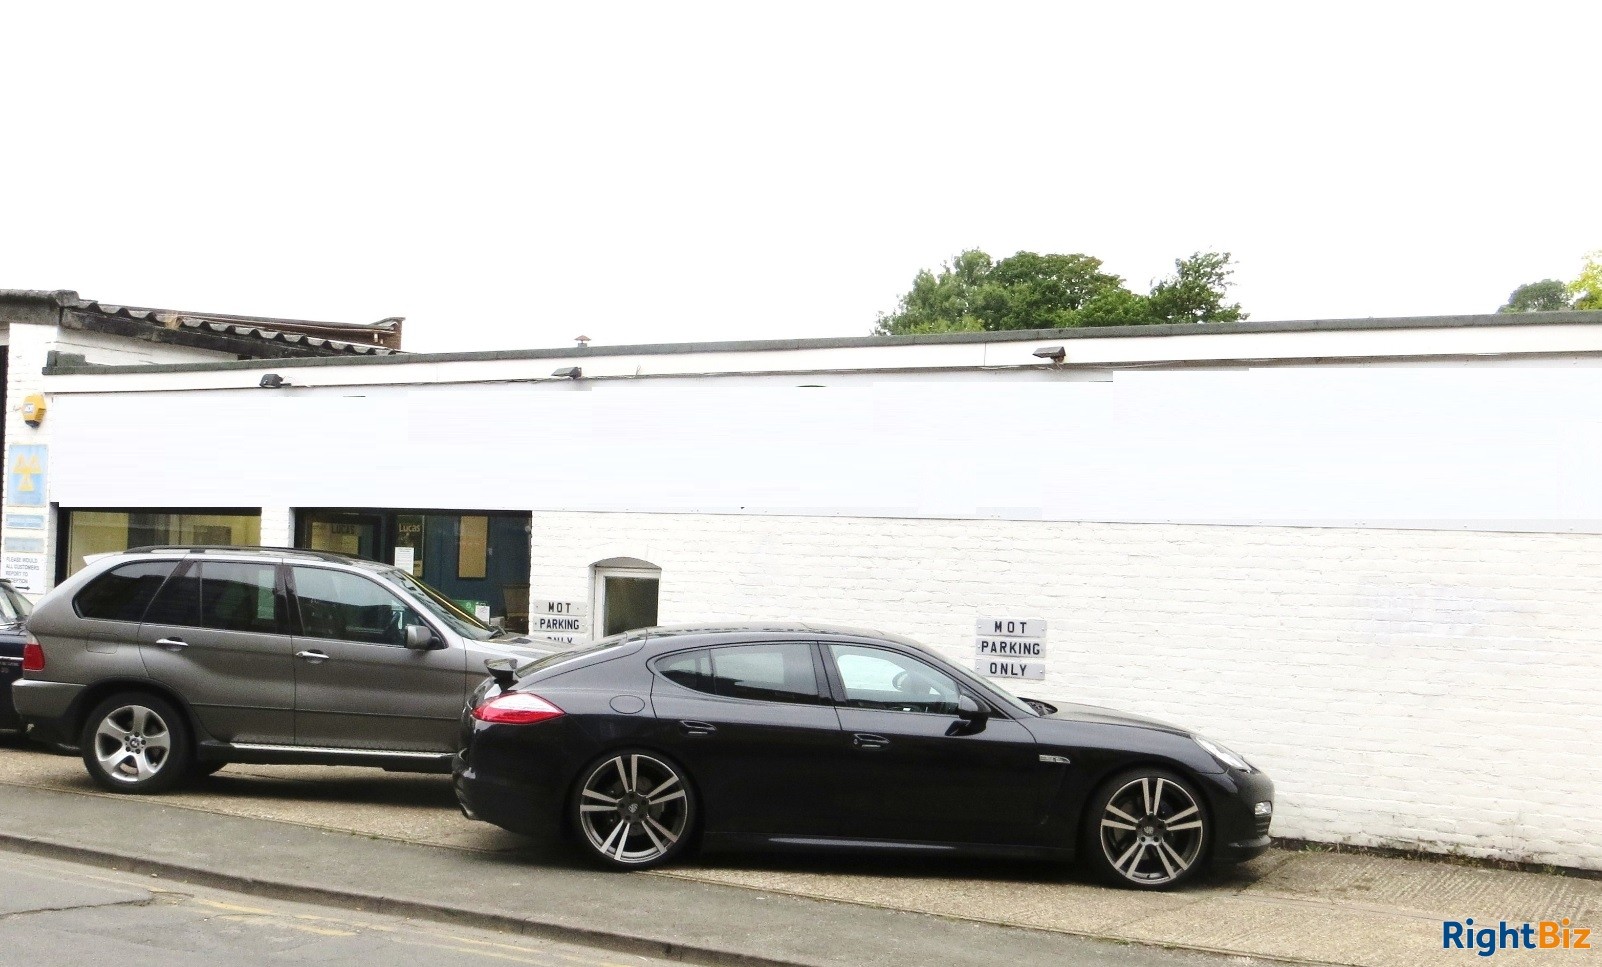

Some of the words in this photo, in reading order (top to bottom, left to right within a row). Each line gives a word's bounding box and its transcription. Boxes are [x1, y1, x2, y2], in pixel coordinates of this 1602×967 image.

[399, 523, 421, 533] Lucas
[548, 601, 571, 613] MOT
[540, 618, 580, 630] PARKING
[994, 620, 1027, 634] MOT
[981, 640, 1040, 655] PARKING
[989, 662, 1027, 677] ONLY
